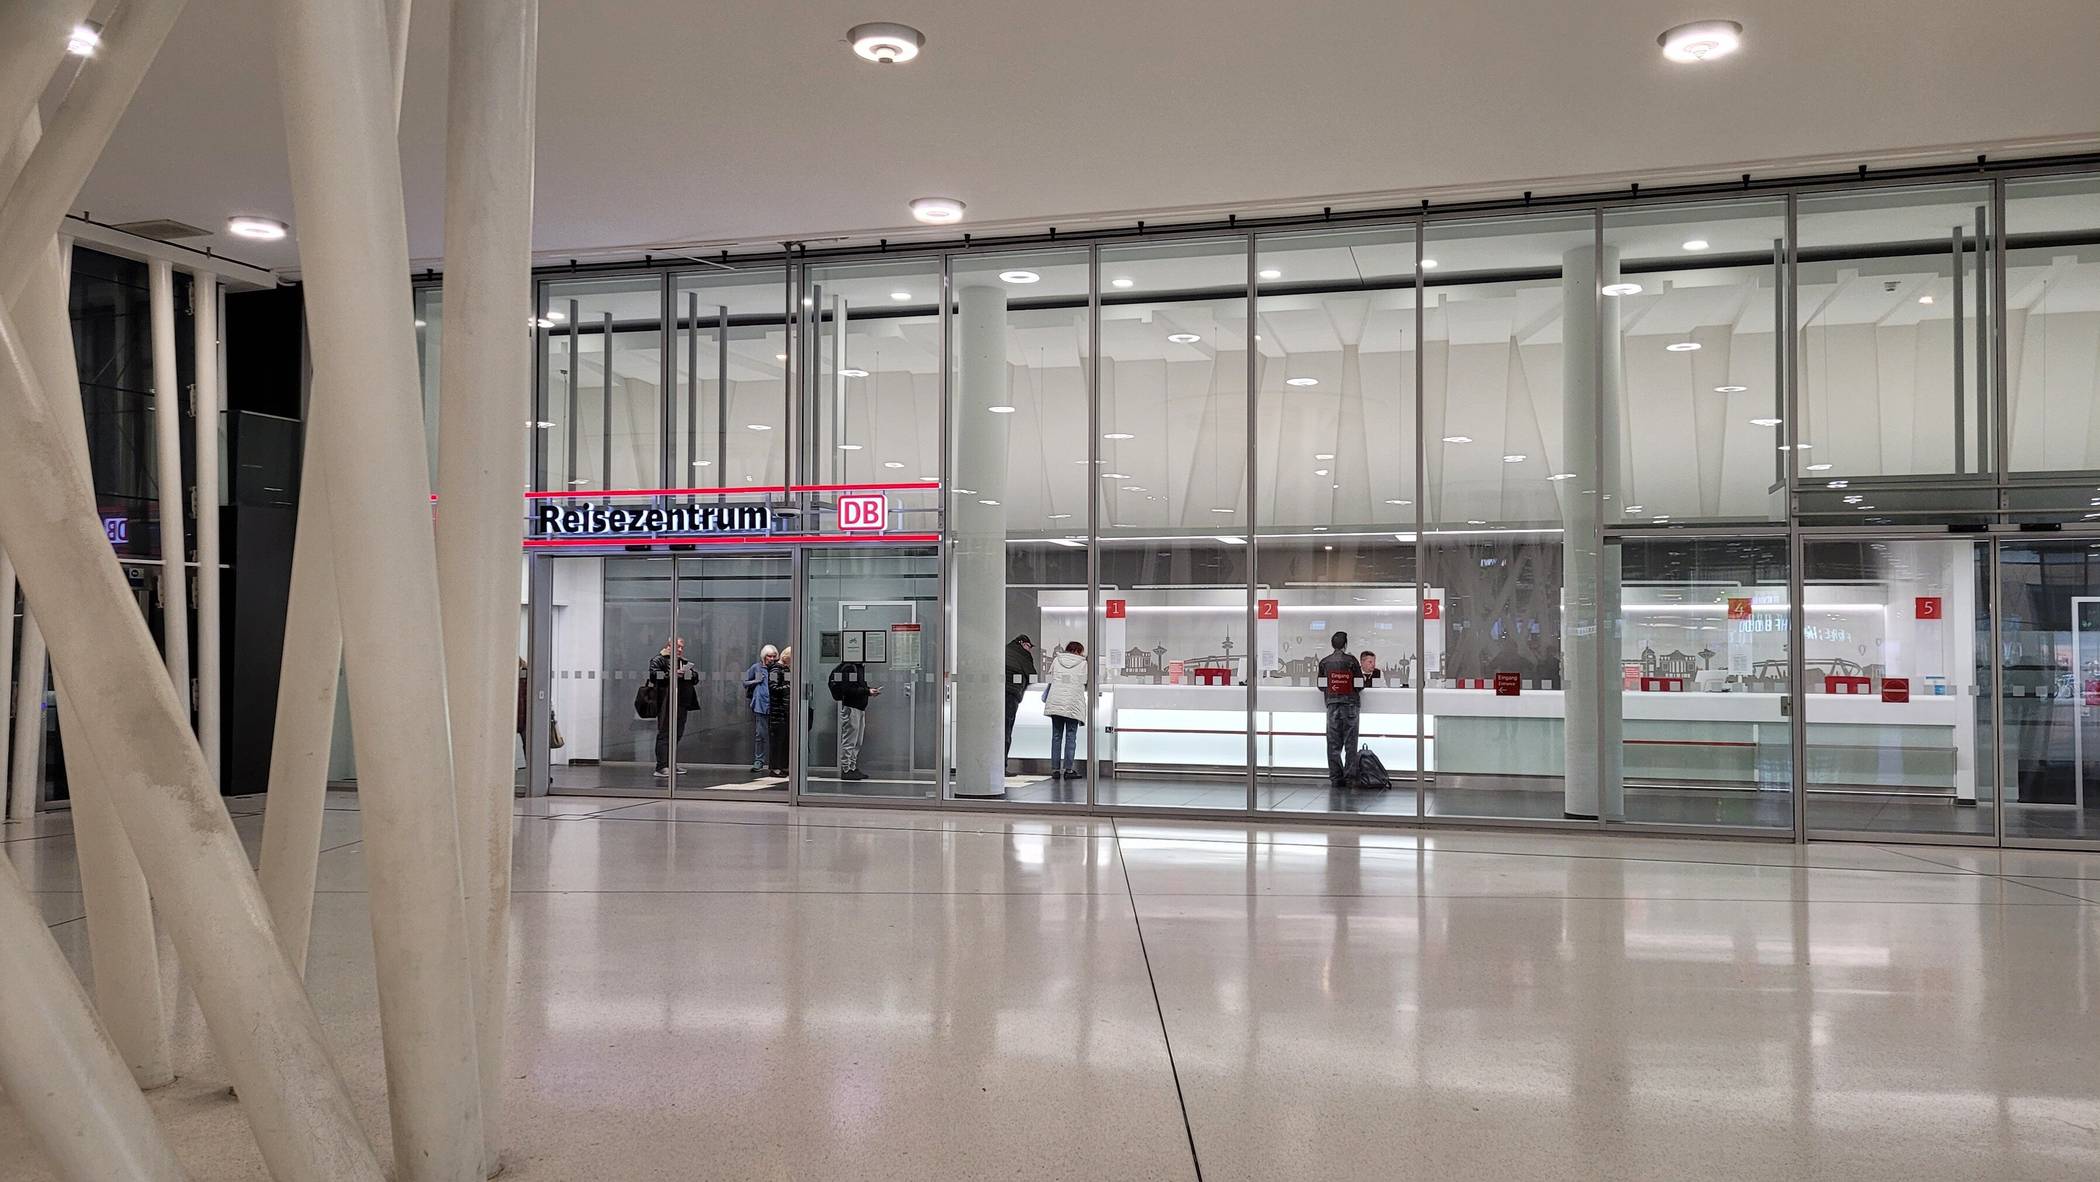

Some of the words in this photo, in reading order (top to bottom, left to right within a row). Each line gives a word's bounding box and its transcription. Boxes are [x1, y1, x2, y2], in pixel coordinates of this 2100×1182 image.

[540, 503, 769, 533] Reisezentrum
[844, 501, 880, 525] DB
[1112, 602, 1120, 614] 1
[1264, 602, 1273, 616] 2
[1424, 602, 1433, 616] 3
[1734, 602, 1745, 616] 4
[1923, 601, 1934, 615] 5
[1331, 672, 1350, 680] Eingang
